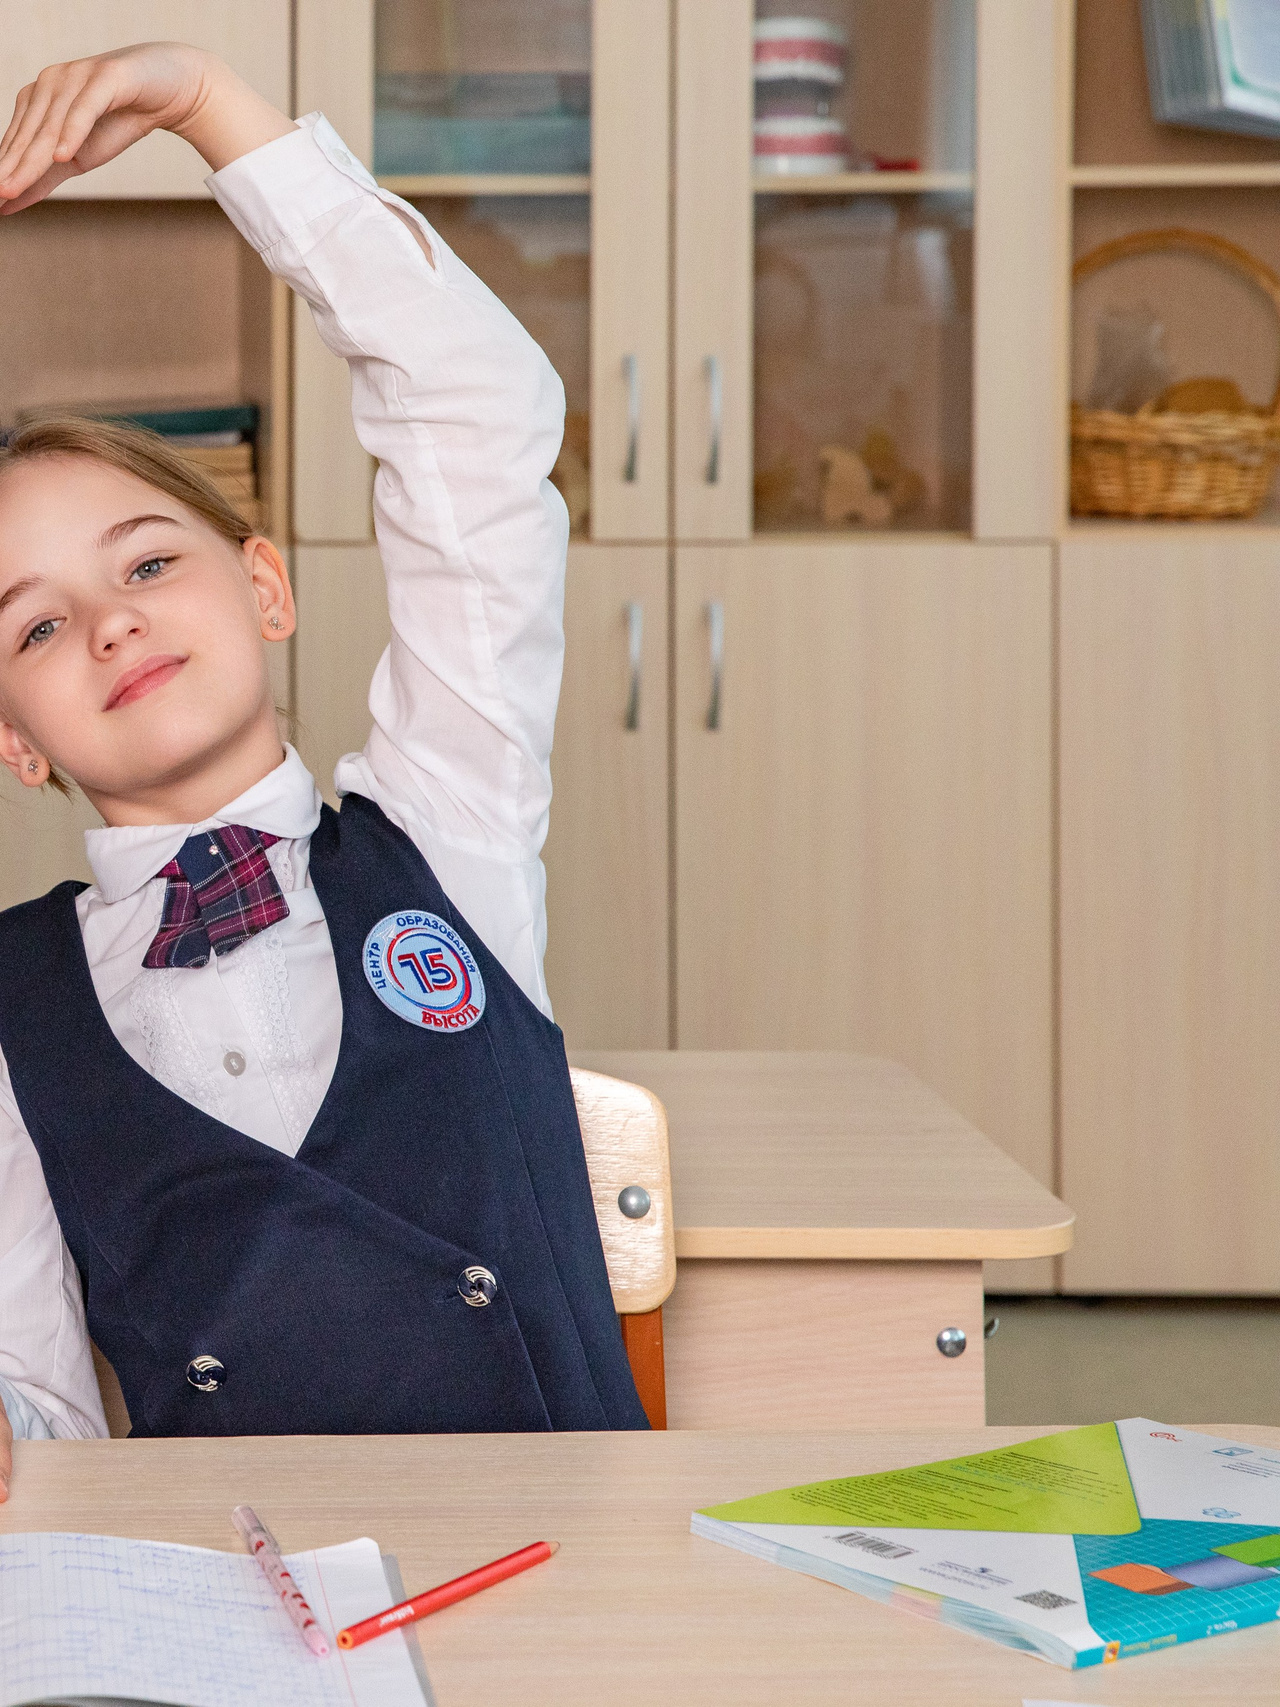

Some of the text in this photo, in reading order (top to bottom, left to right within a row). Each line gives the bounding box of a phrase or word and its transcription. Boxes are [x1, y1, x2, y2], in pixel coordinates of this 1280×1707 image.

[366, 915, 476, 990] ЦЕНТР ОБРАЗОВАНИЯ
[421, 1003, 480, 1029] ВЫСОТА
